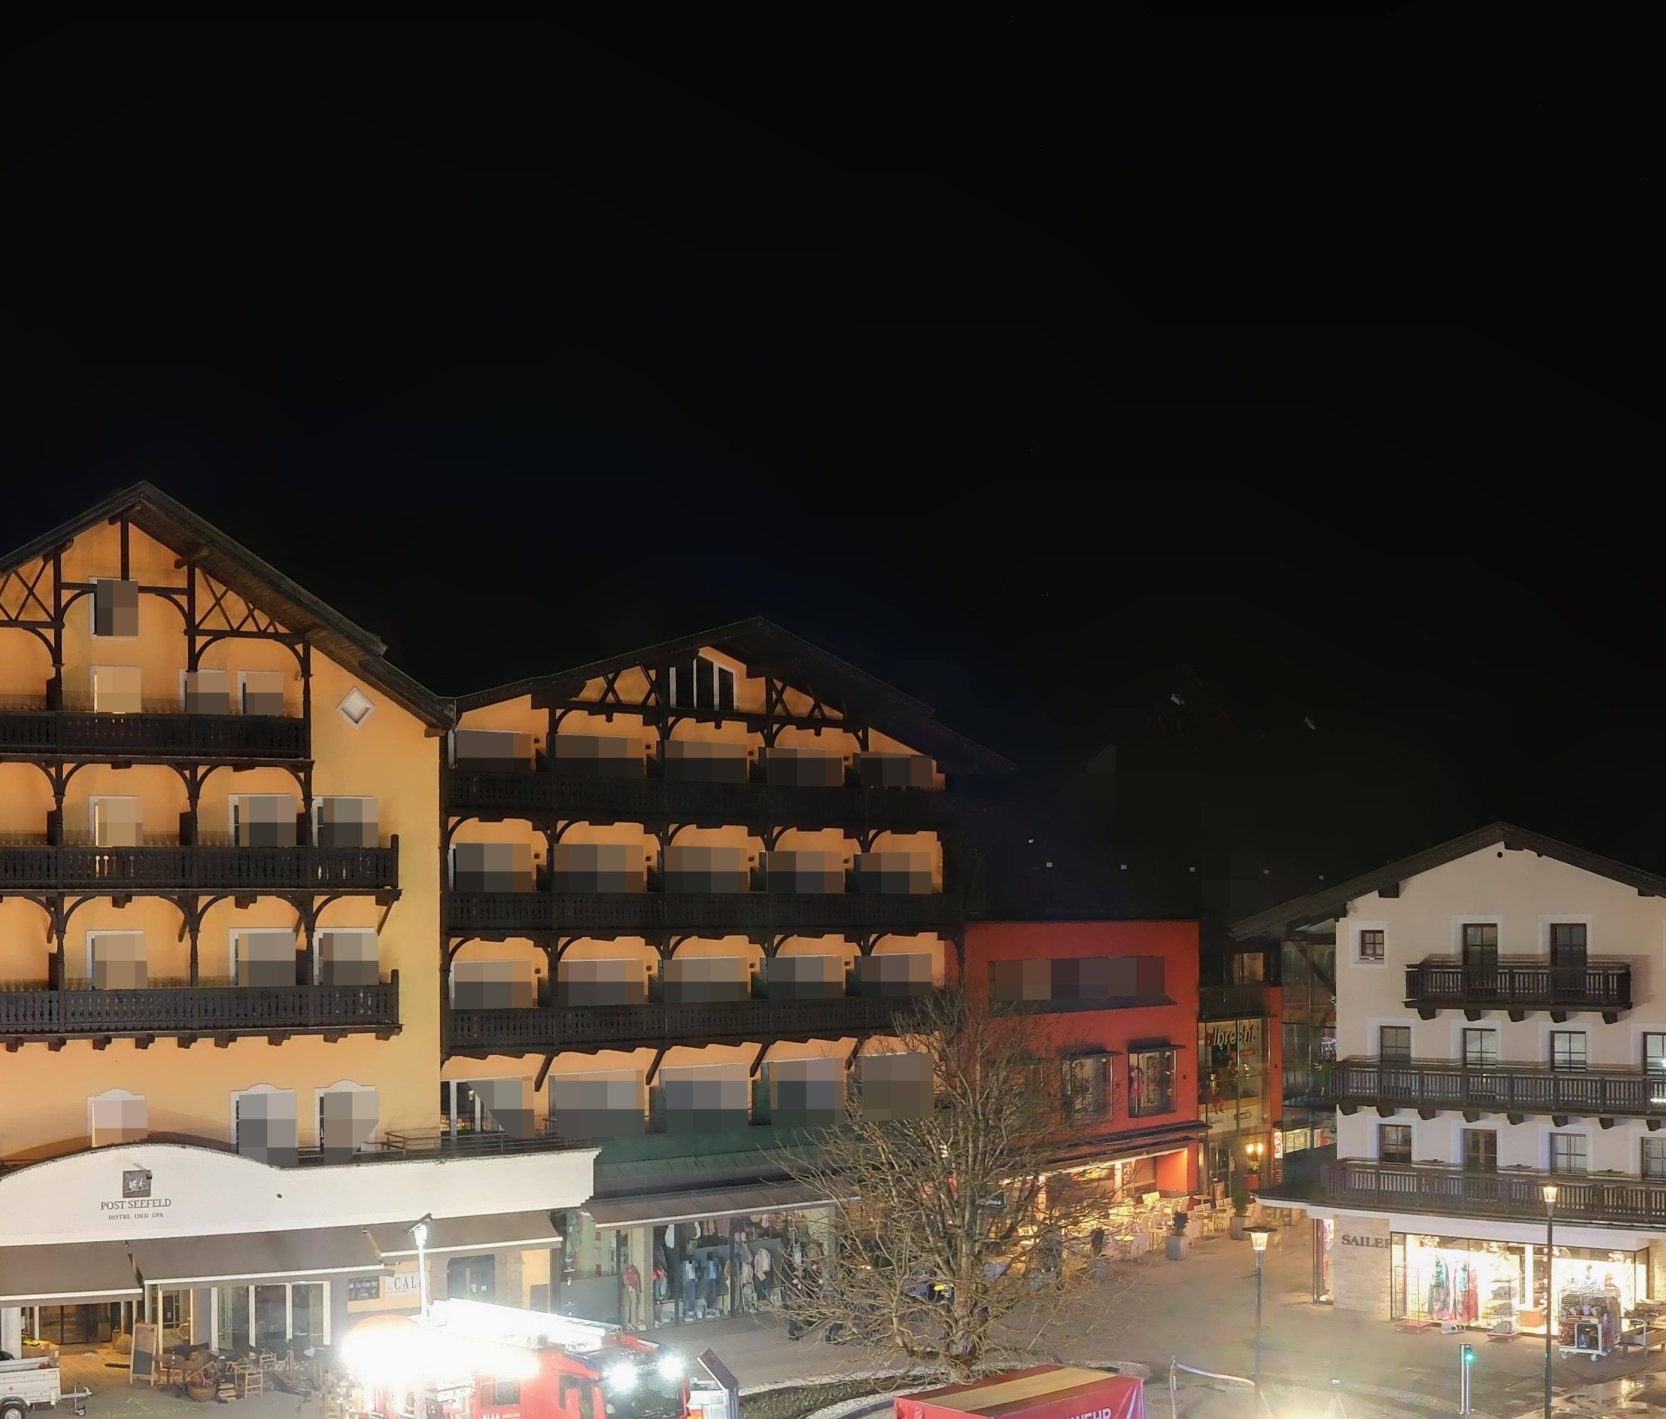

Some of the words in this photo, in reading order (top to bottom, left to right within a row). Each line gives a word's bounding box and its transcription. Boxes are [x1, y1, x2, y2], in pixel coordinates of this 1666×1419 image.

[100, 1201, 127, 1210] POST
[128, 1198, 171, 1209] SEEFELD
[393, 1276, 420, 1290] CAL
